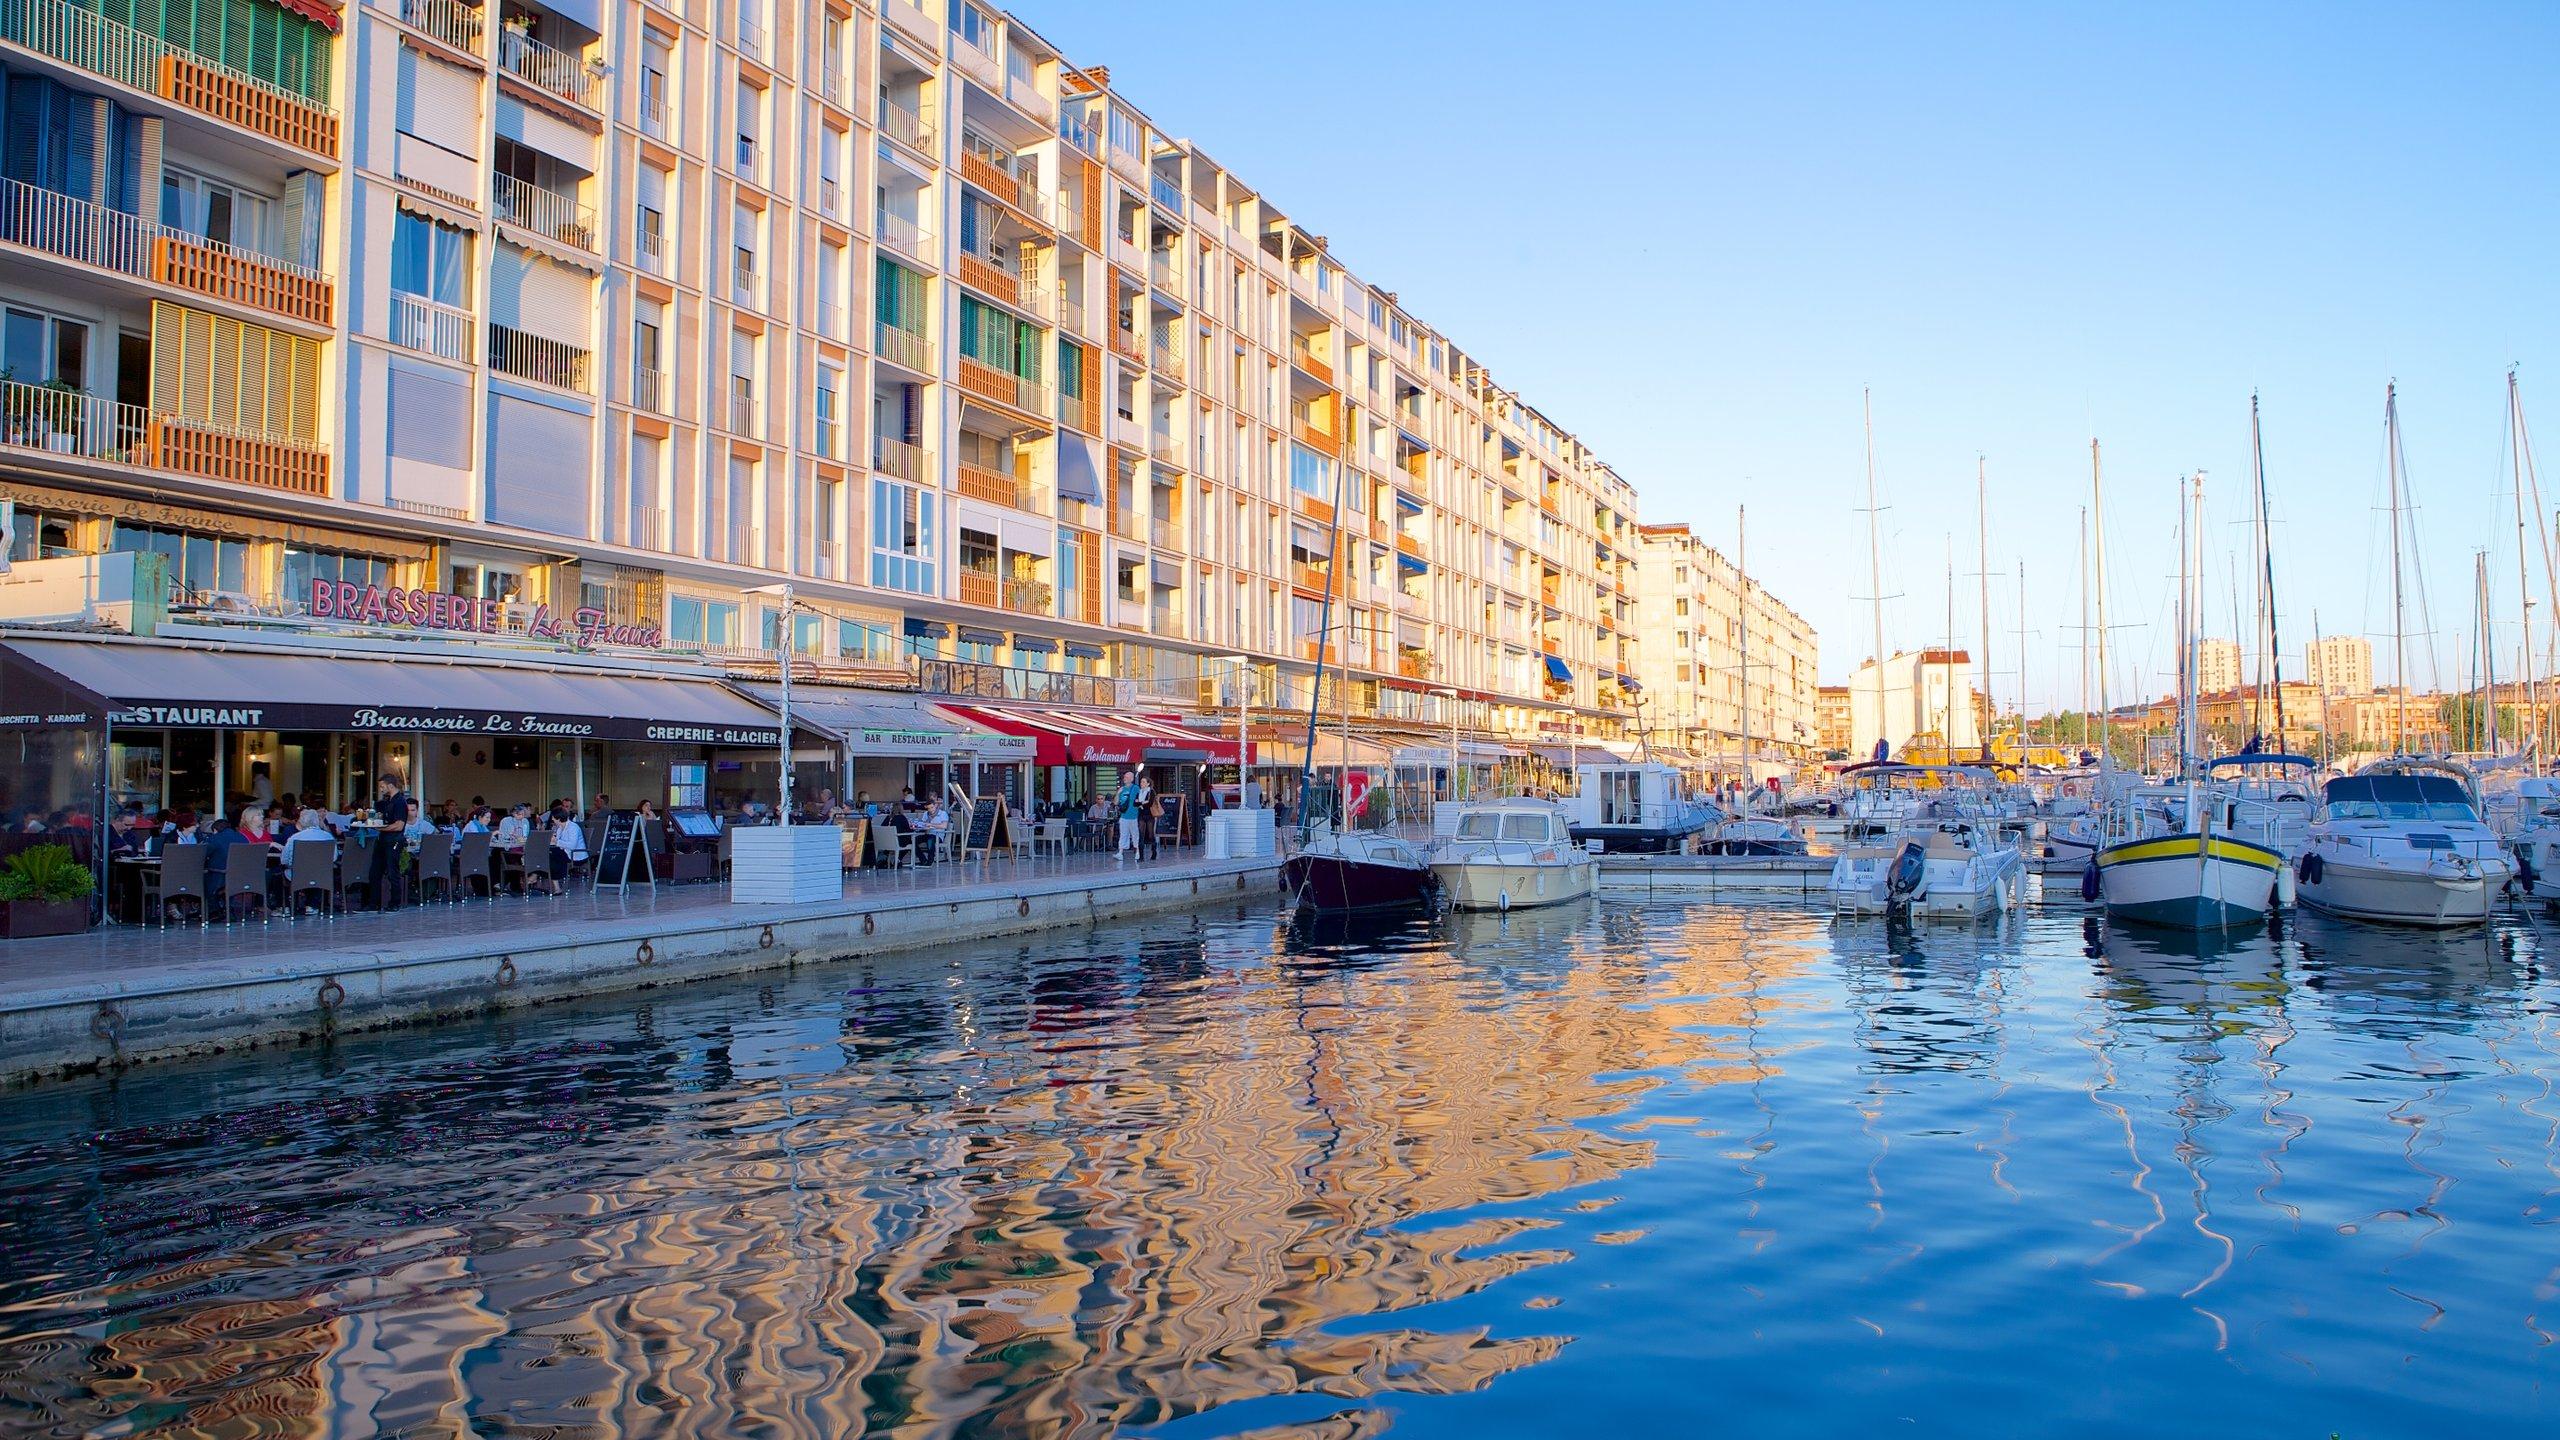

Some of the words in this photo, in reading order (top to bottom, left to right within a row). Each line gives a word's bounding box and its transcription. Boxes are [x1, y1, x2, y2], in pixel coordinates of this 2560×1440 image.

[121, 502, 149, 517] Le
[157, 507, 234, 530] France
[312, 578, 497, 633] BRASSERIE
[528, 603, 563, 639] Le
[571, 606, 663, 649] France
[351, 709, 475, 729] Brasserie
[482, 714, 512, 731] Le
[519, 715, 592, 735] France
[647, 726, 715, 741] CREPERIE
[723, 730, 777, 744] GLACIER
[865, 734, 881, 743] BAR
[892, 735, 943, 745] RESTAURANT
[999, 738, 1026, 747] GLACIER
[1083, 745, 1131, 762] Restaurant
